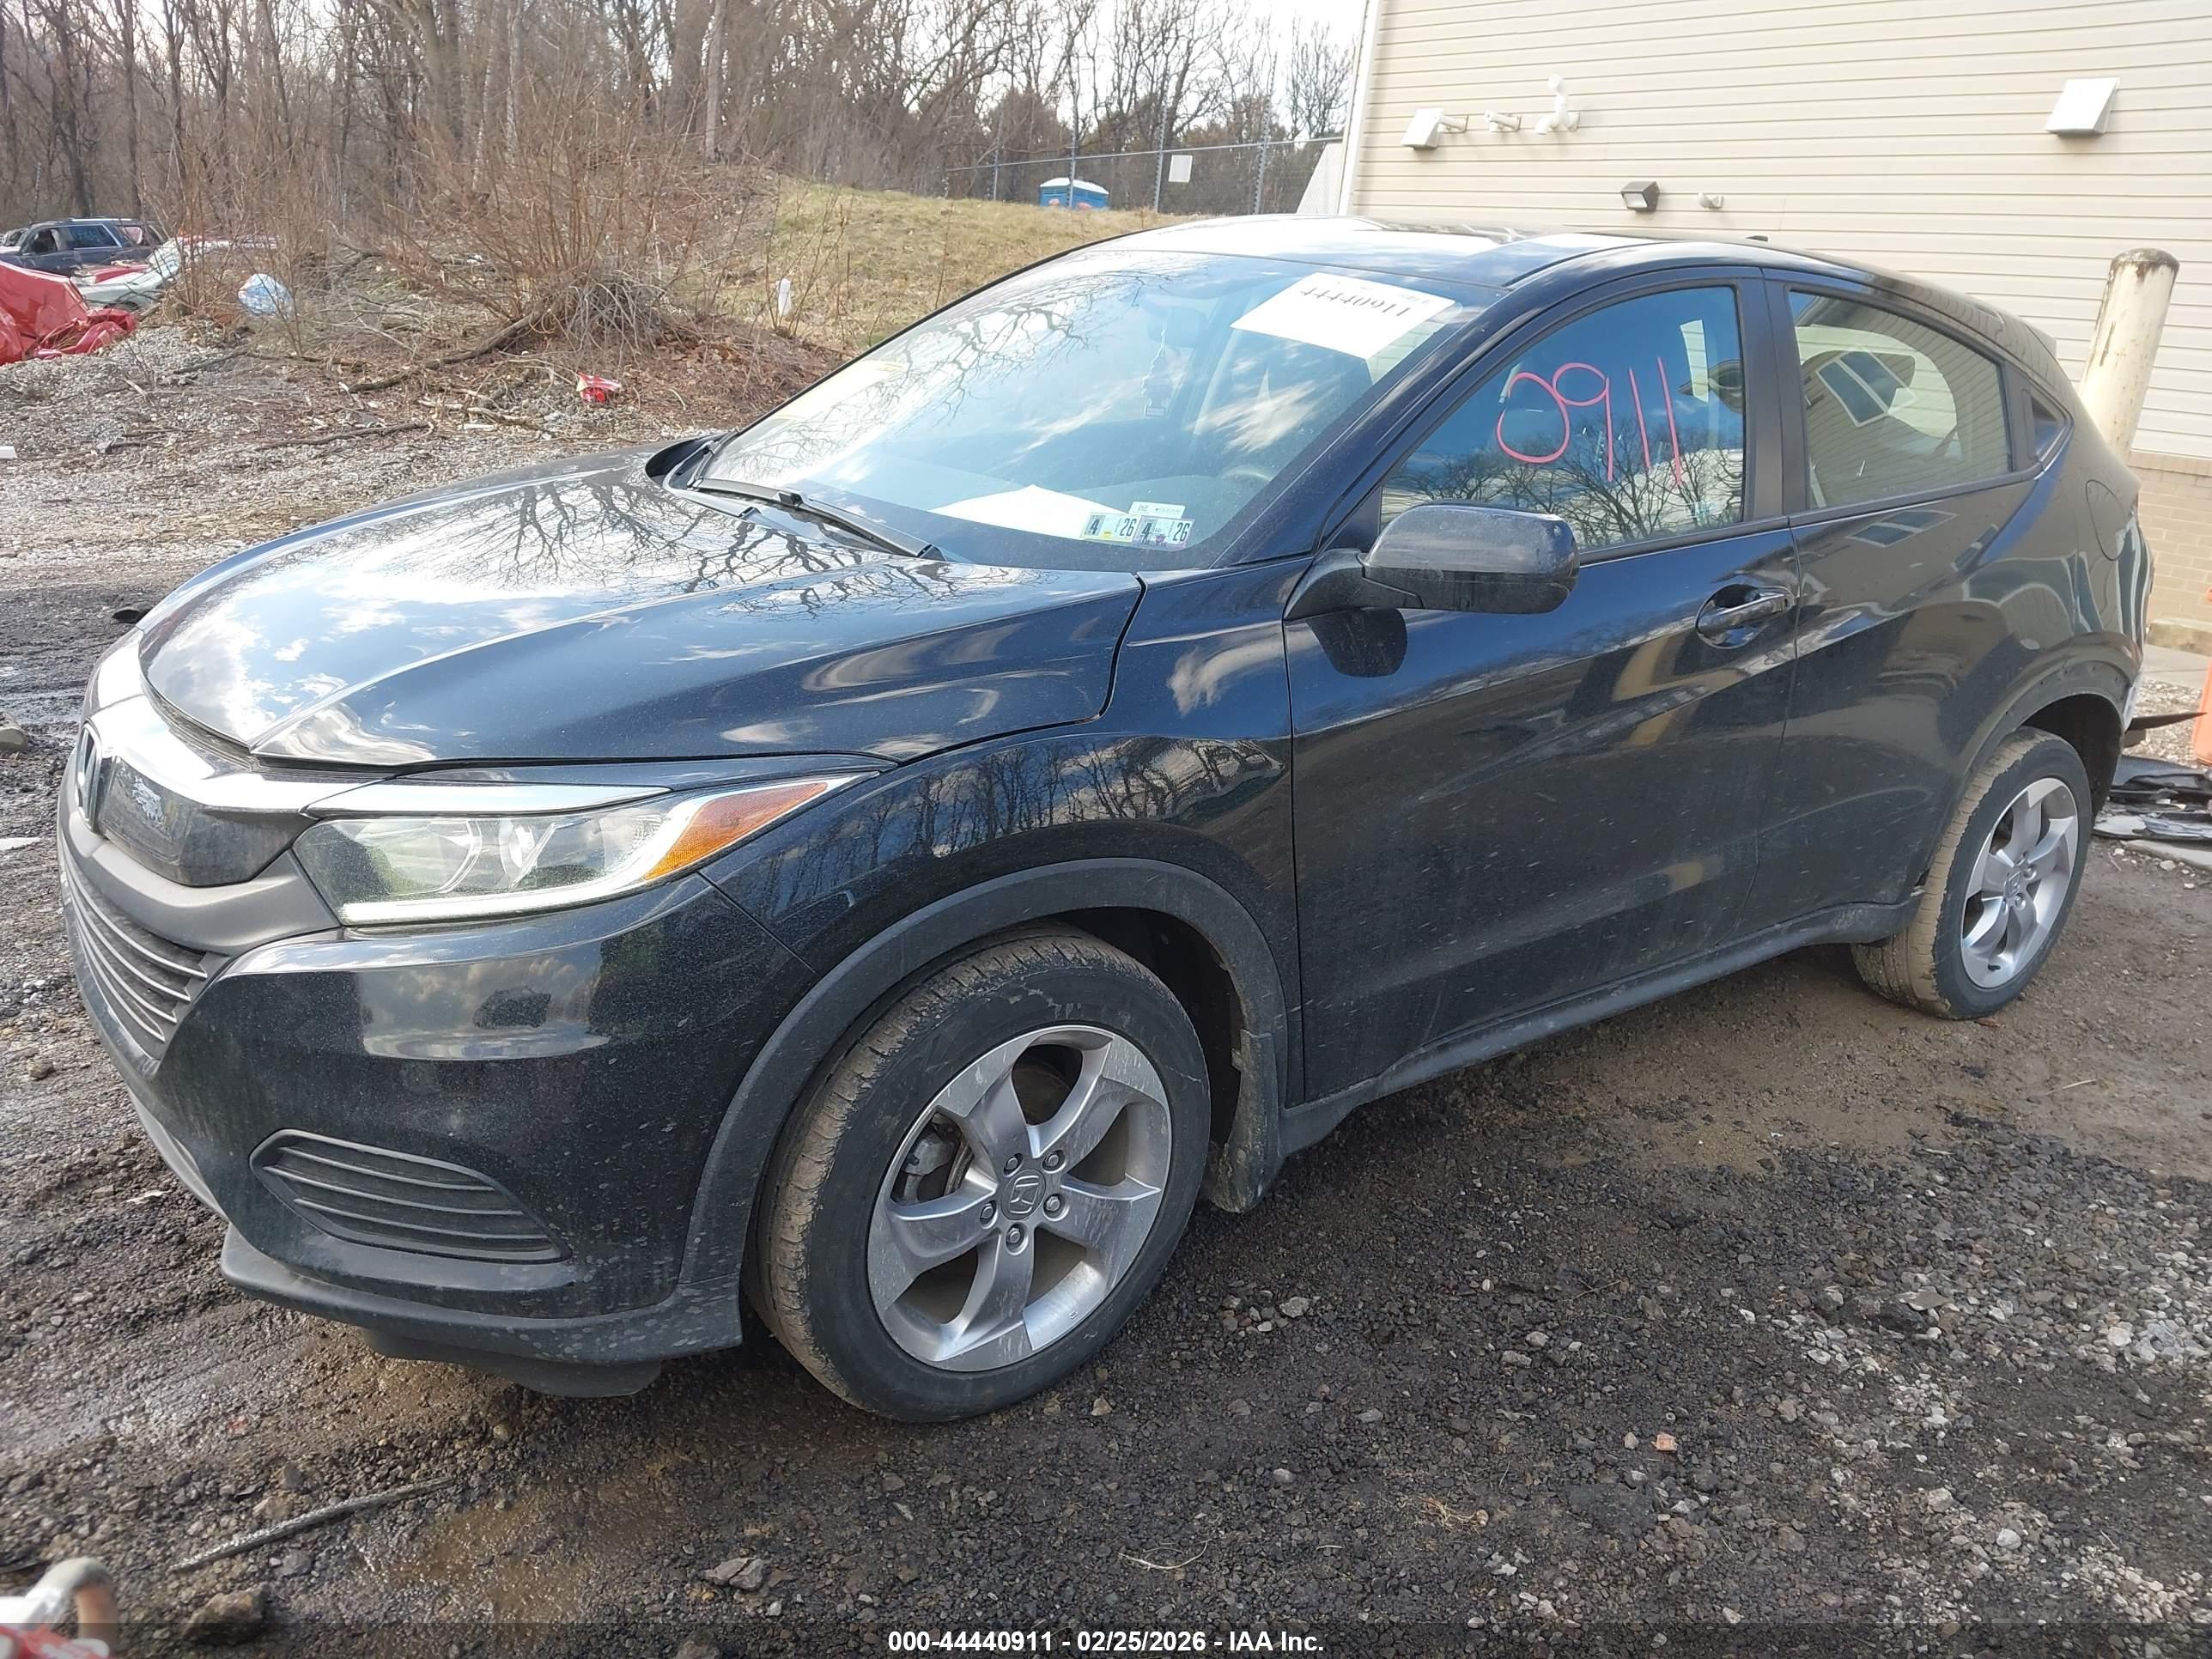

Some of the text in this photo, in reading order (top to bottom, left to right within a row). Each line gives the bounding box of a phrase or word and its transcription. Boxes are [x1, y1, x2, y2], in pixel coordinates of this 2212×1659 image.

[1496, 356, 1684, 487] 0911
[1089, 518, 1138, 537] 4 26
[1140, 522, 1191, 542] 4 26
